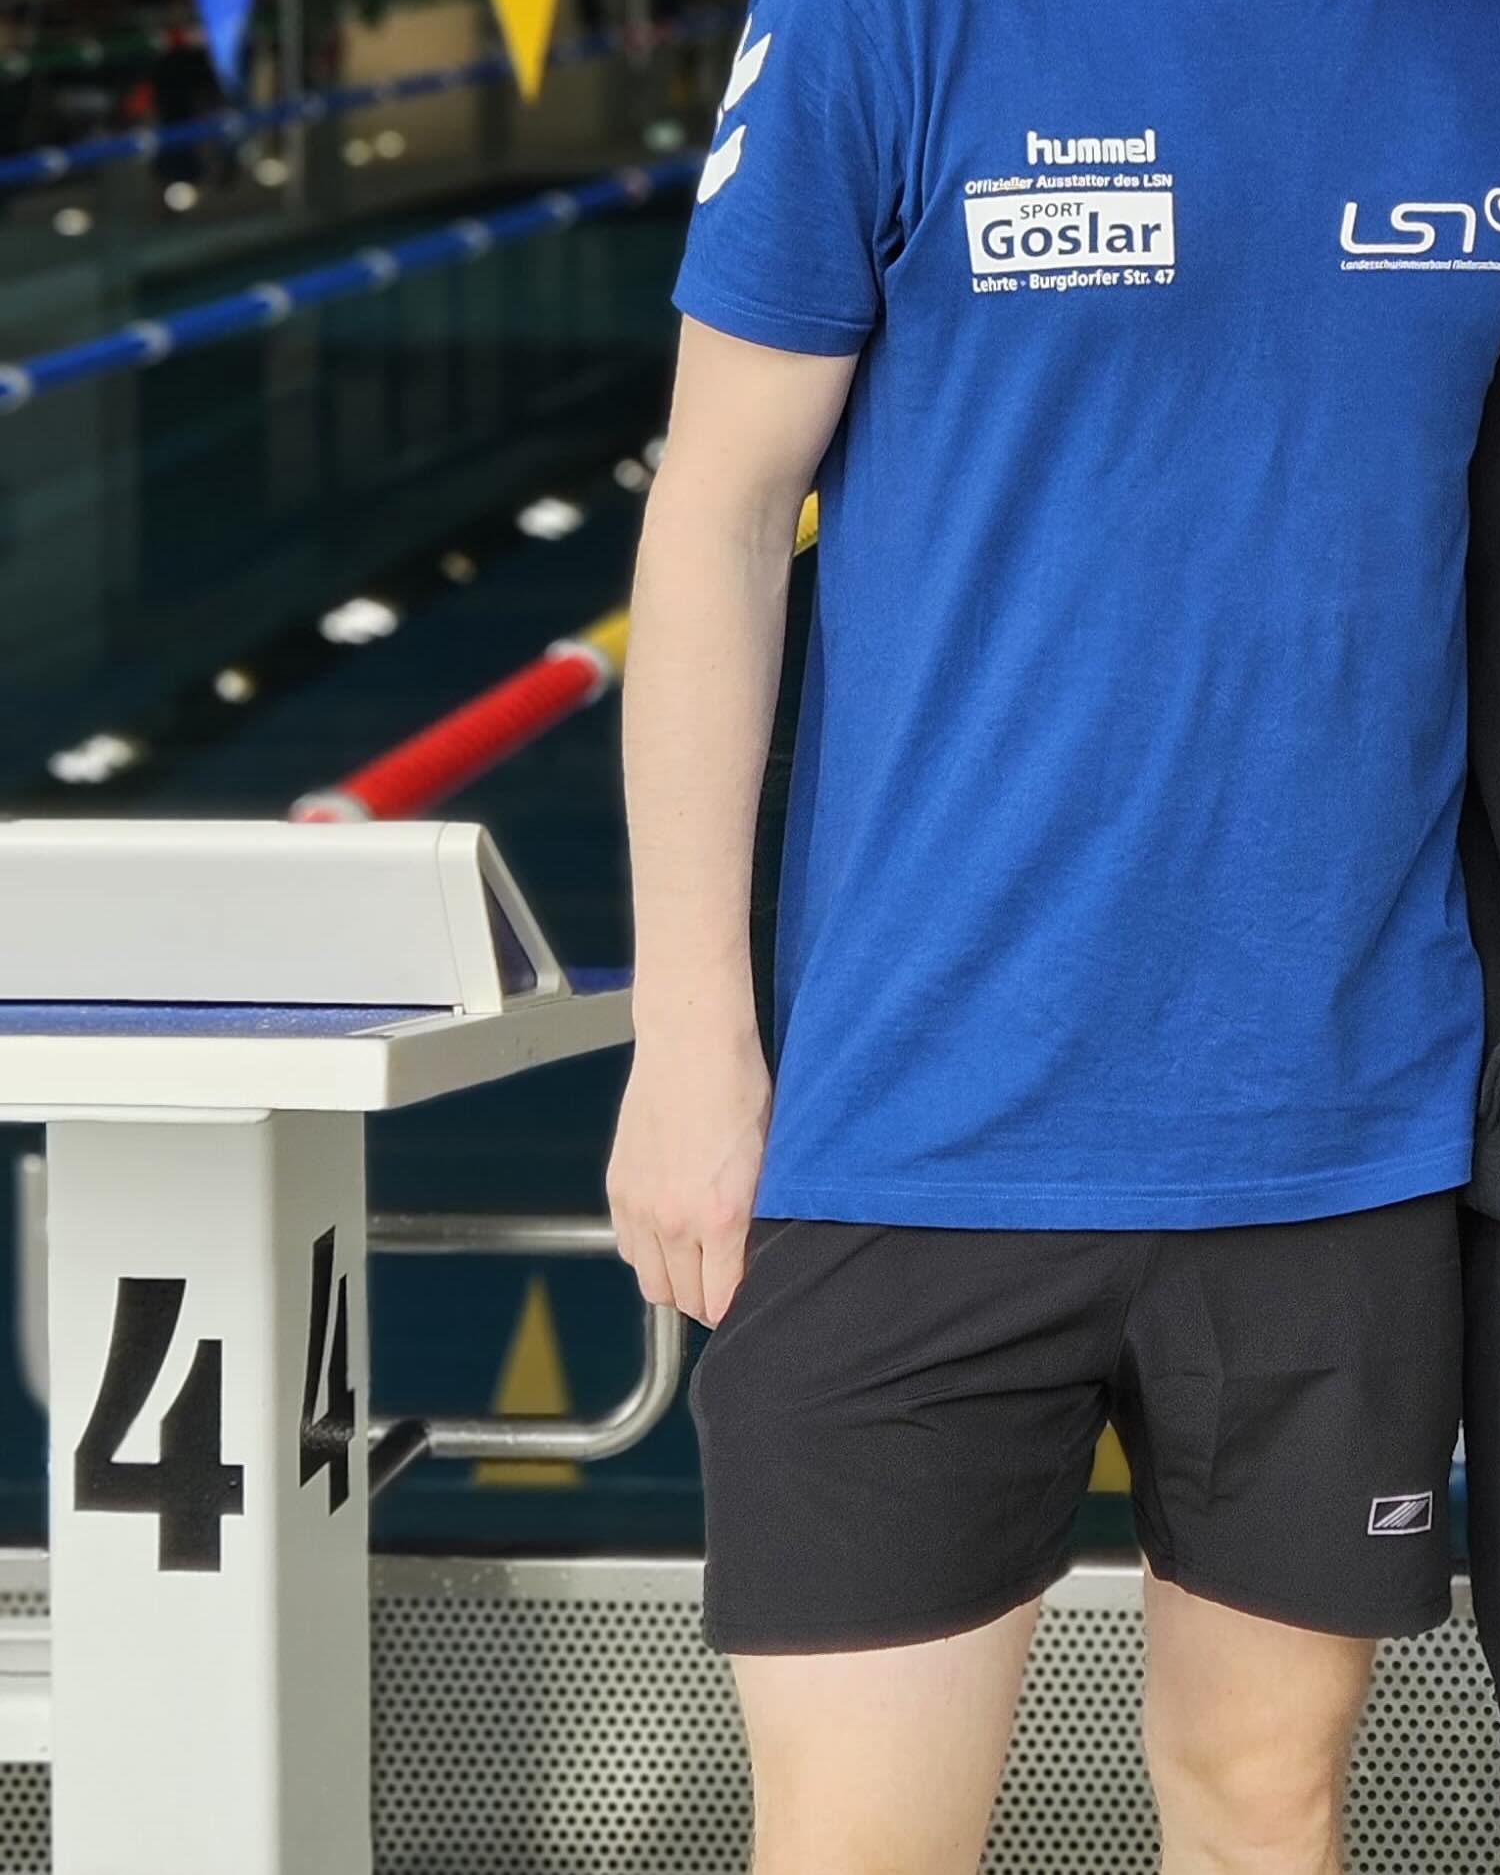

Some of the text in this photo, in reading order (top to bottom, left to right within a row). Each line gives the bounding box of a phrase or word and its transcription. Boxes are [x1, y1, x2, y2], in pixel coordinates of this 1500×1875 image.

[1027, 128, 1156, 165] hummel
[1036, 175, 1110, 189] Ausstatter
[1113, 174, 1139, 188] des
[1143, 174, 1173, 188] LSN
[1020, 202, 1084, 220] SPORT
[981, 211, 1162, 261] Goslar
[972, 269, 1175, 294] Lehrte Burgdorfer Str. 47
[300, 1224, 355, 1516] 4
[73, 1277, 244, 1572] 4
